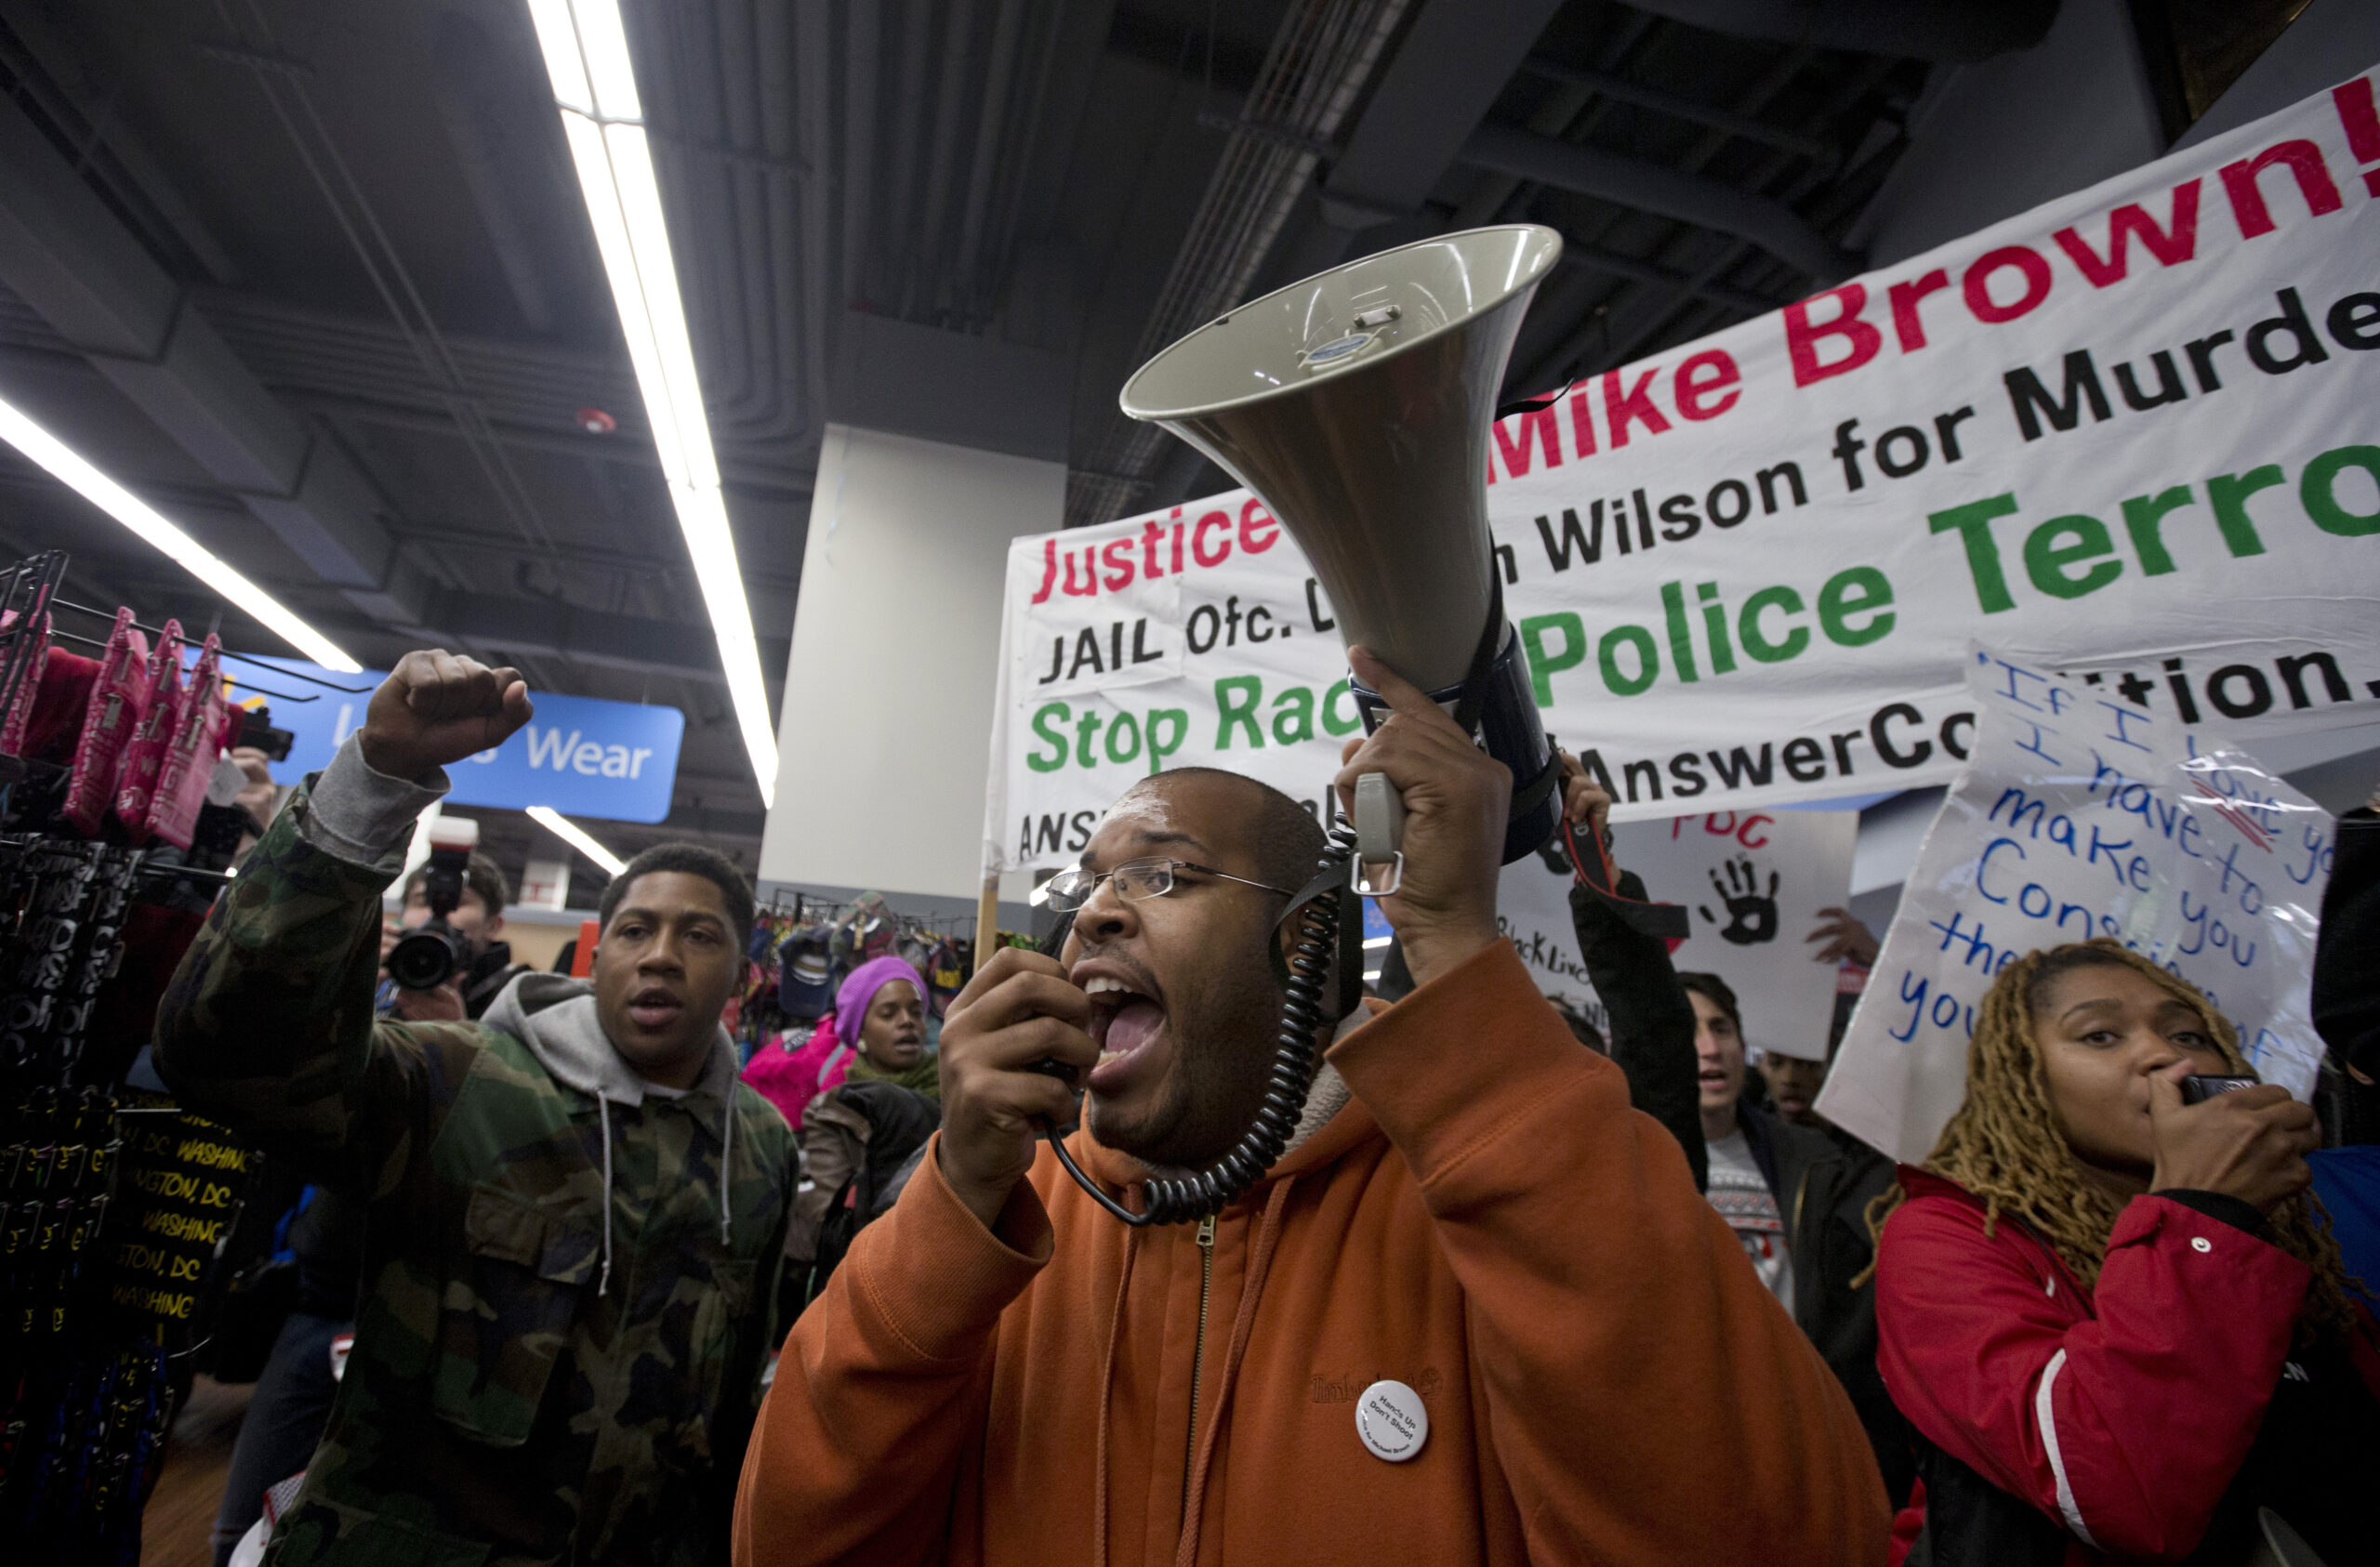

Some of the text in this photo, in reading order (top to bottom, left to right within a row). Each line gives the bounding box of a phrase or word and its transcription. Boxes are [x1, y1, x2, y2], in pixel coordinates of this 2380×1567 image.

[1031, 76, 2380, 604] Justice Mike Brown!
[1038, 618, 1163, 685] JAIL
[1186, 596, 1291, 654] Ofc.
[1535, 488, 1809, 573] Wilson
[1831, 405, 1976, 494] for
[2003, 286, 2380, 442] Murde
[1027, 445, 2380, 774] Stop Rac Police Terro
[526, 725, 652, 781] Wear
[1021, 810, 1106, 861] ANS
[2089, 745, 2202, 858] have
[2215, 842, 2265, 916] to
[2284, 824, 2334, 885] yo
[1989, 786, 2258, 968] make you
[199, 1181, 231, 1208] DC
[169, 1254, 202, 1282] DC
[1368, 1400, 1414, 1441] Don't Shoot
